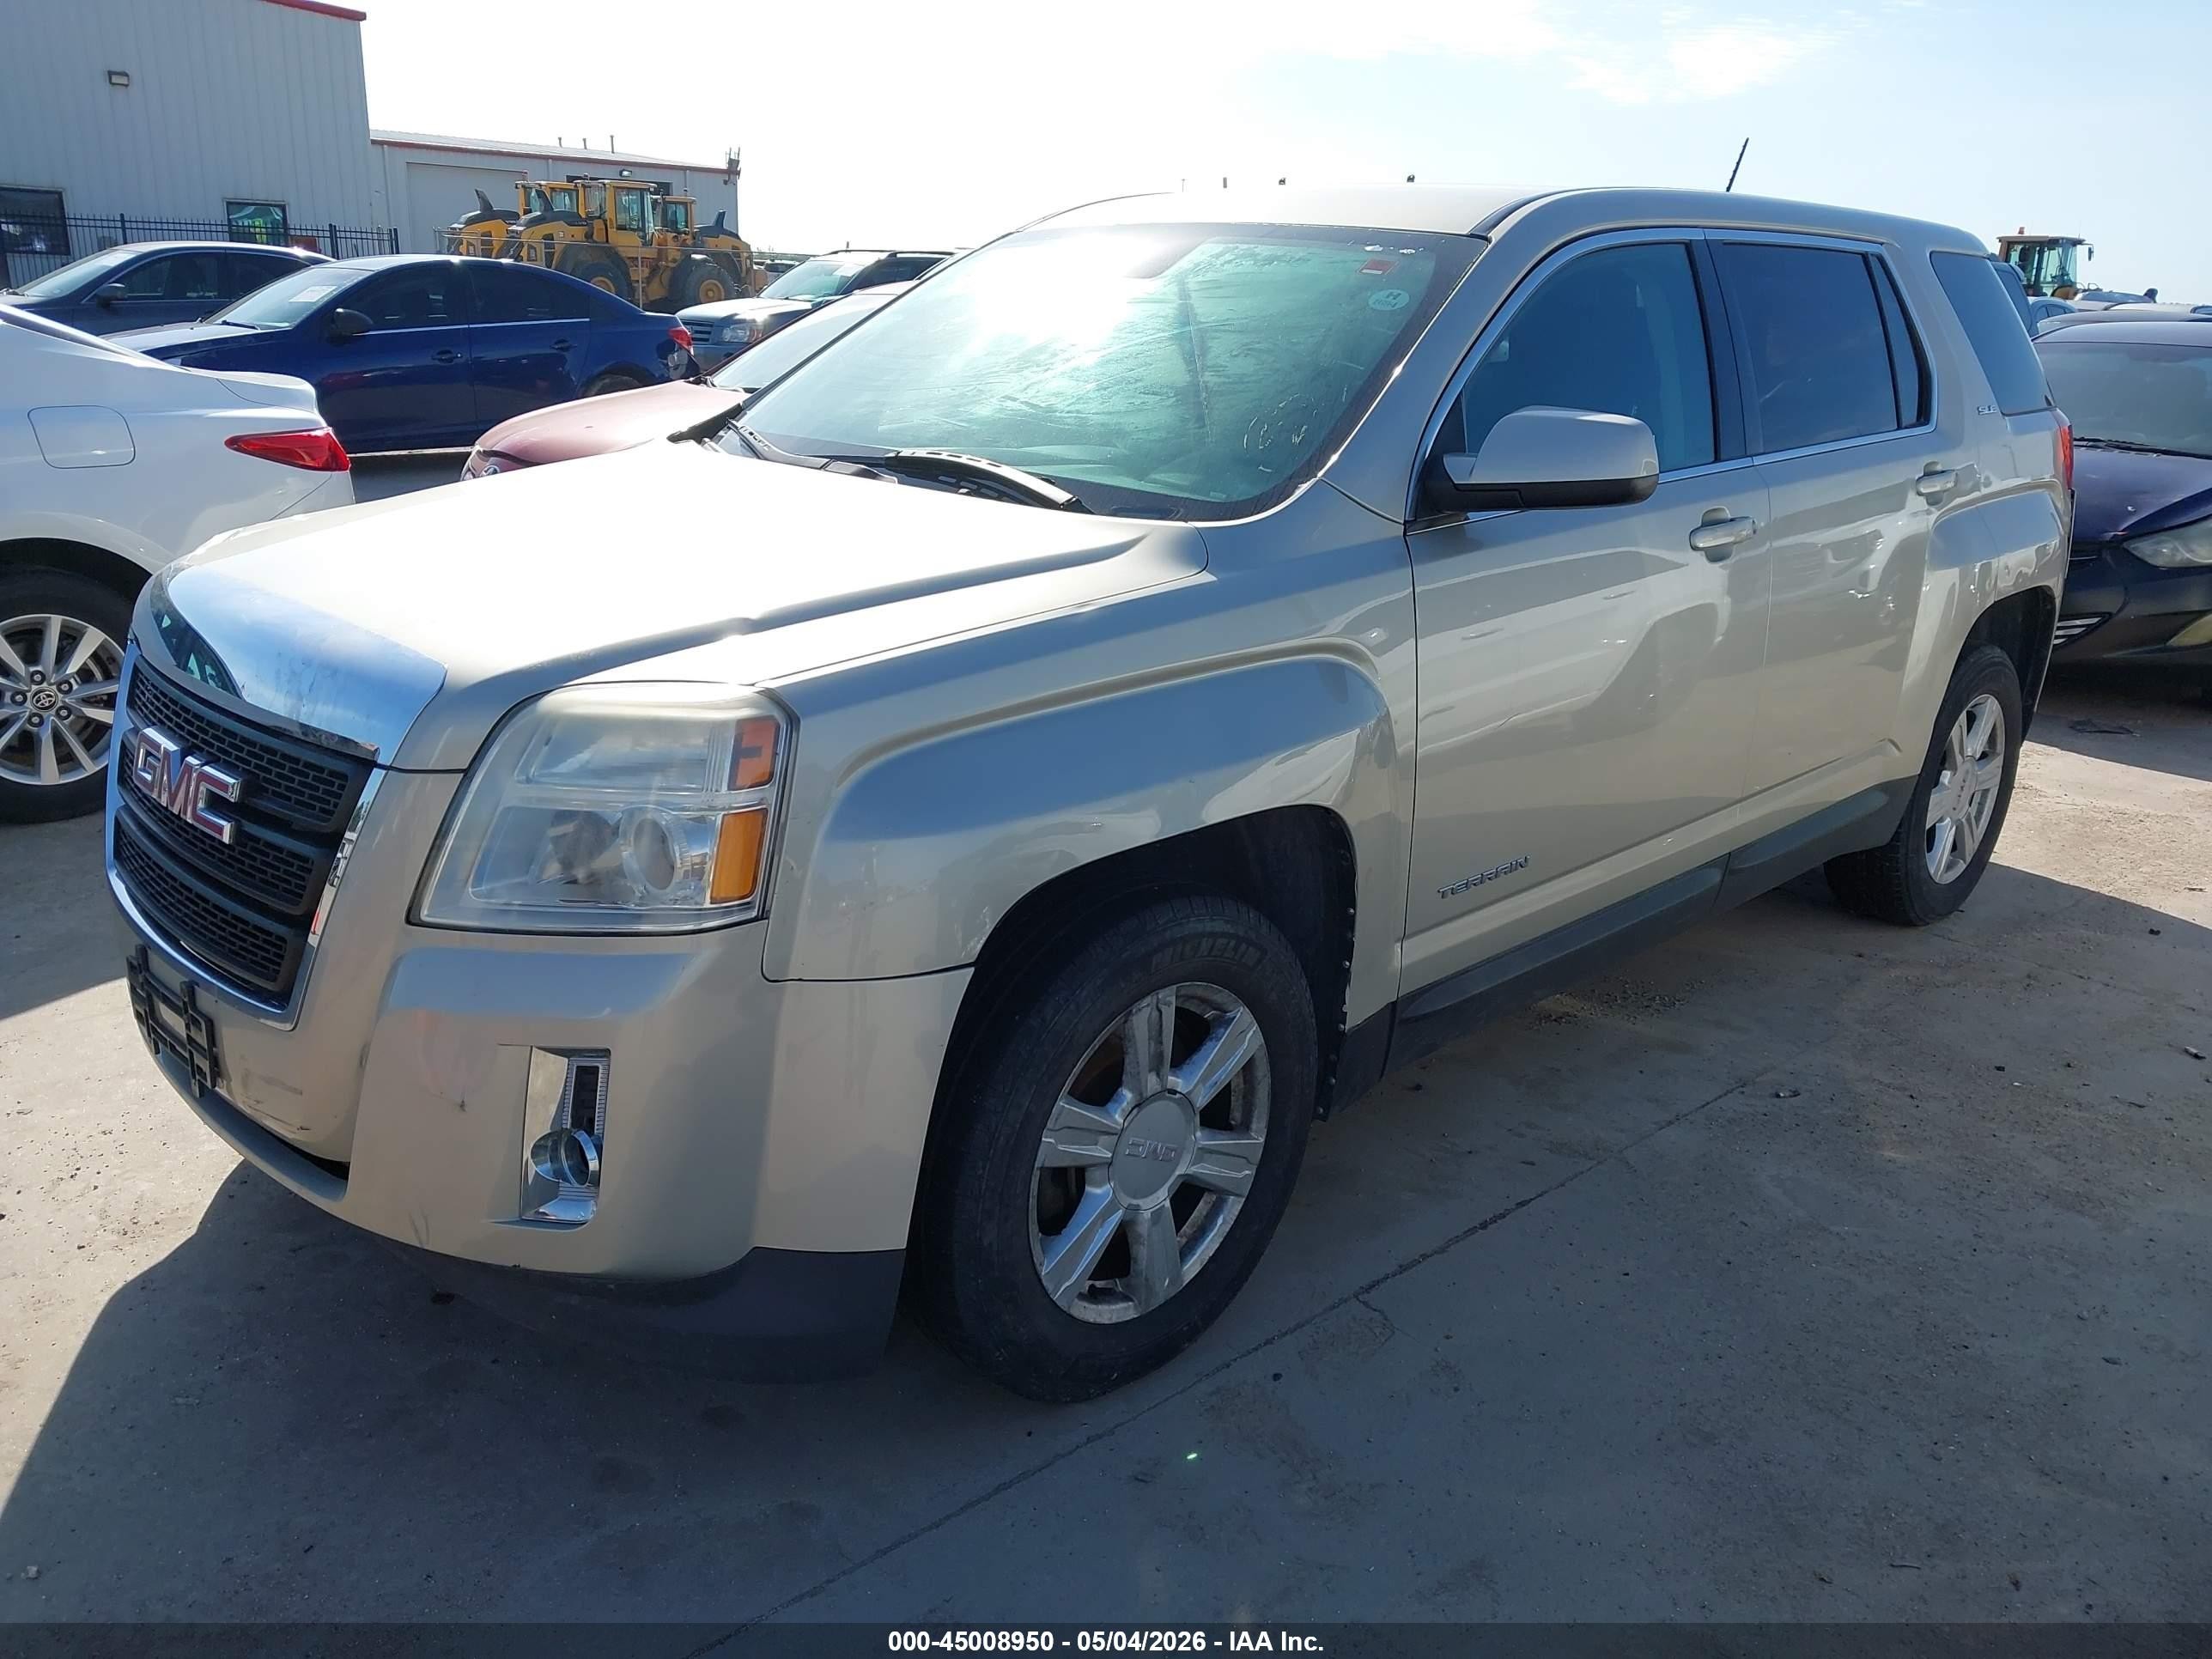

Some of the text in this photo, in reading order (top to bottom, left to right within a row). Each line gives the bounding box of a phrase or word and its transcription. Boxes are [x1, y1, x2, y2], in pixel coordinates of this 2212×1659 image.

[133, 727, 241, 844] GMC
[1437, 855, 1530, 899] TERRAIN
[1149, 937, 1264, 974] MICHELIN
